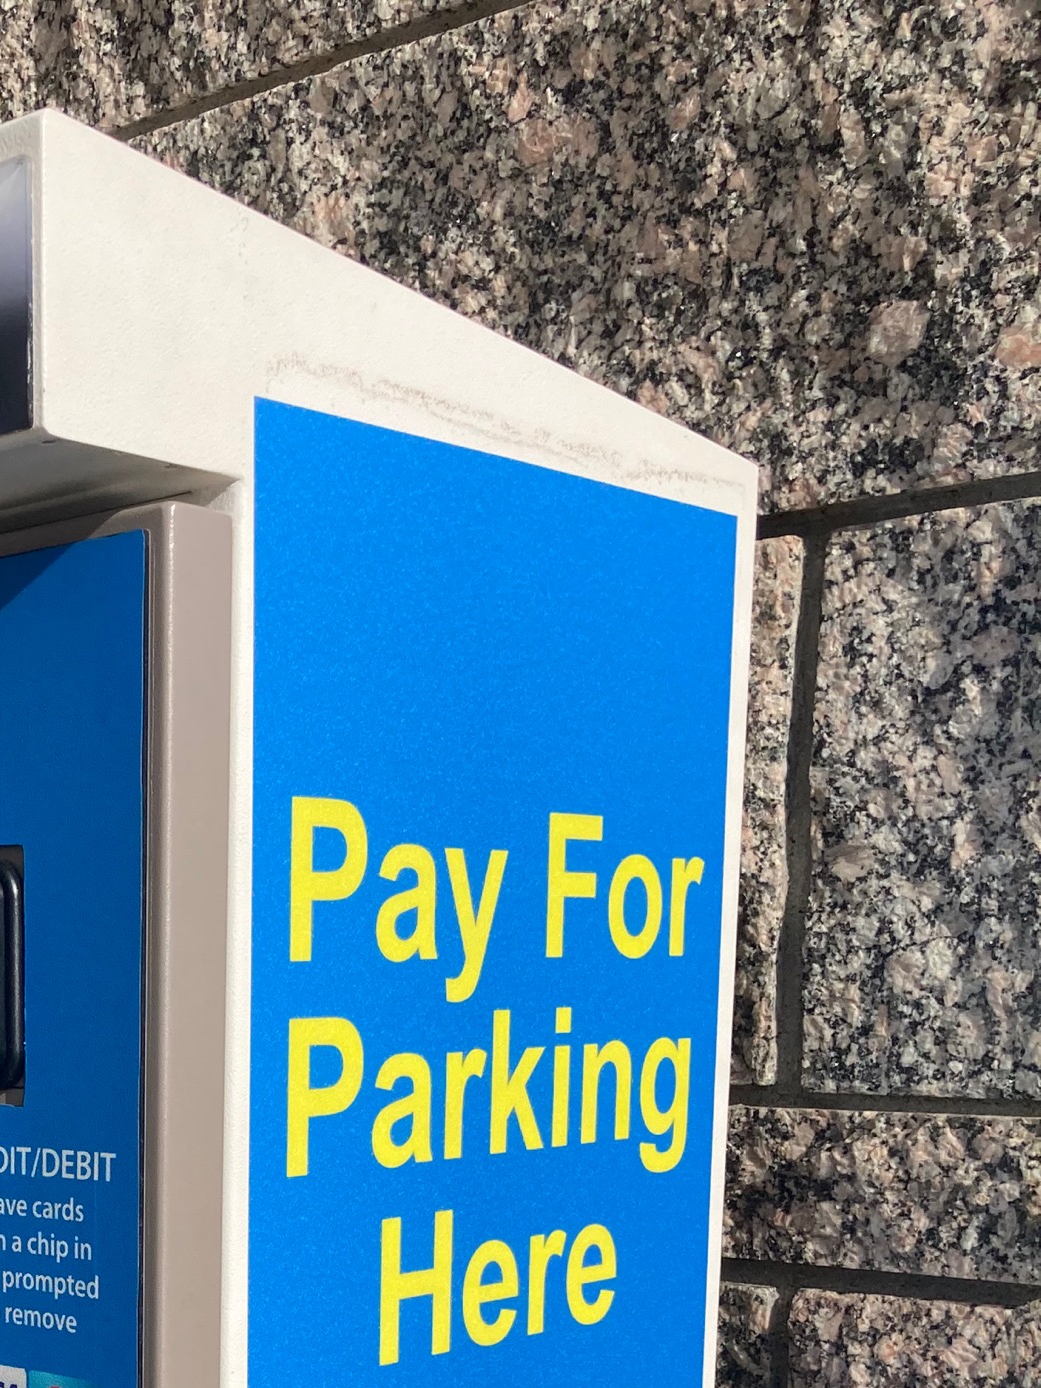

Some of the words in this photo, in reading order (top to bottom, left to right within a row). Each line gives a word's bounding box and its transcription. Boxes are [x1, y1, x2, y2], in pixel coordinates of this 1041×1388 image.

[289, 796, 509, 1003] Pay
[545, 812, 706, 960] For
[286, 1007, 692, 1178] Parking
[32, 1197, 84, 1222] cards
[12, 1235, 22, 1253] a
[27, 1231, 68, 1263] chip
[74, 1236, 92, 1260] in
[2, 1270, 99, 1300] prompted
[379, 1209, 618, 1367] Here
[5, 1306, 77, 1333] remove
